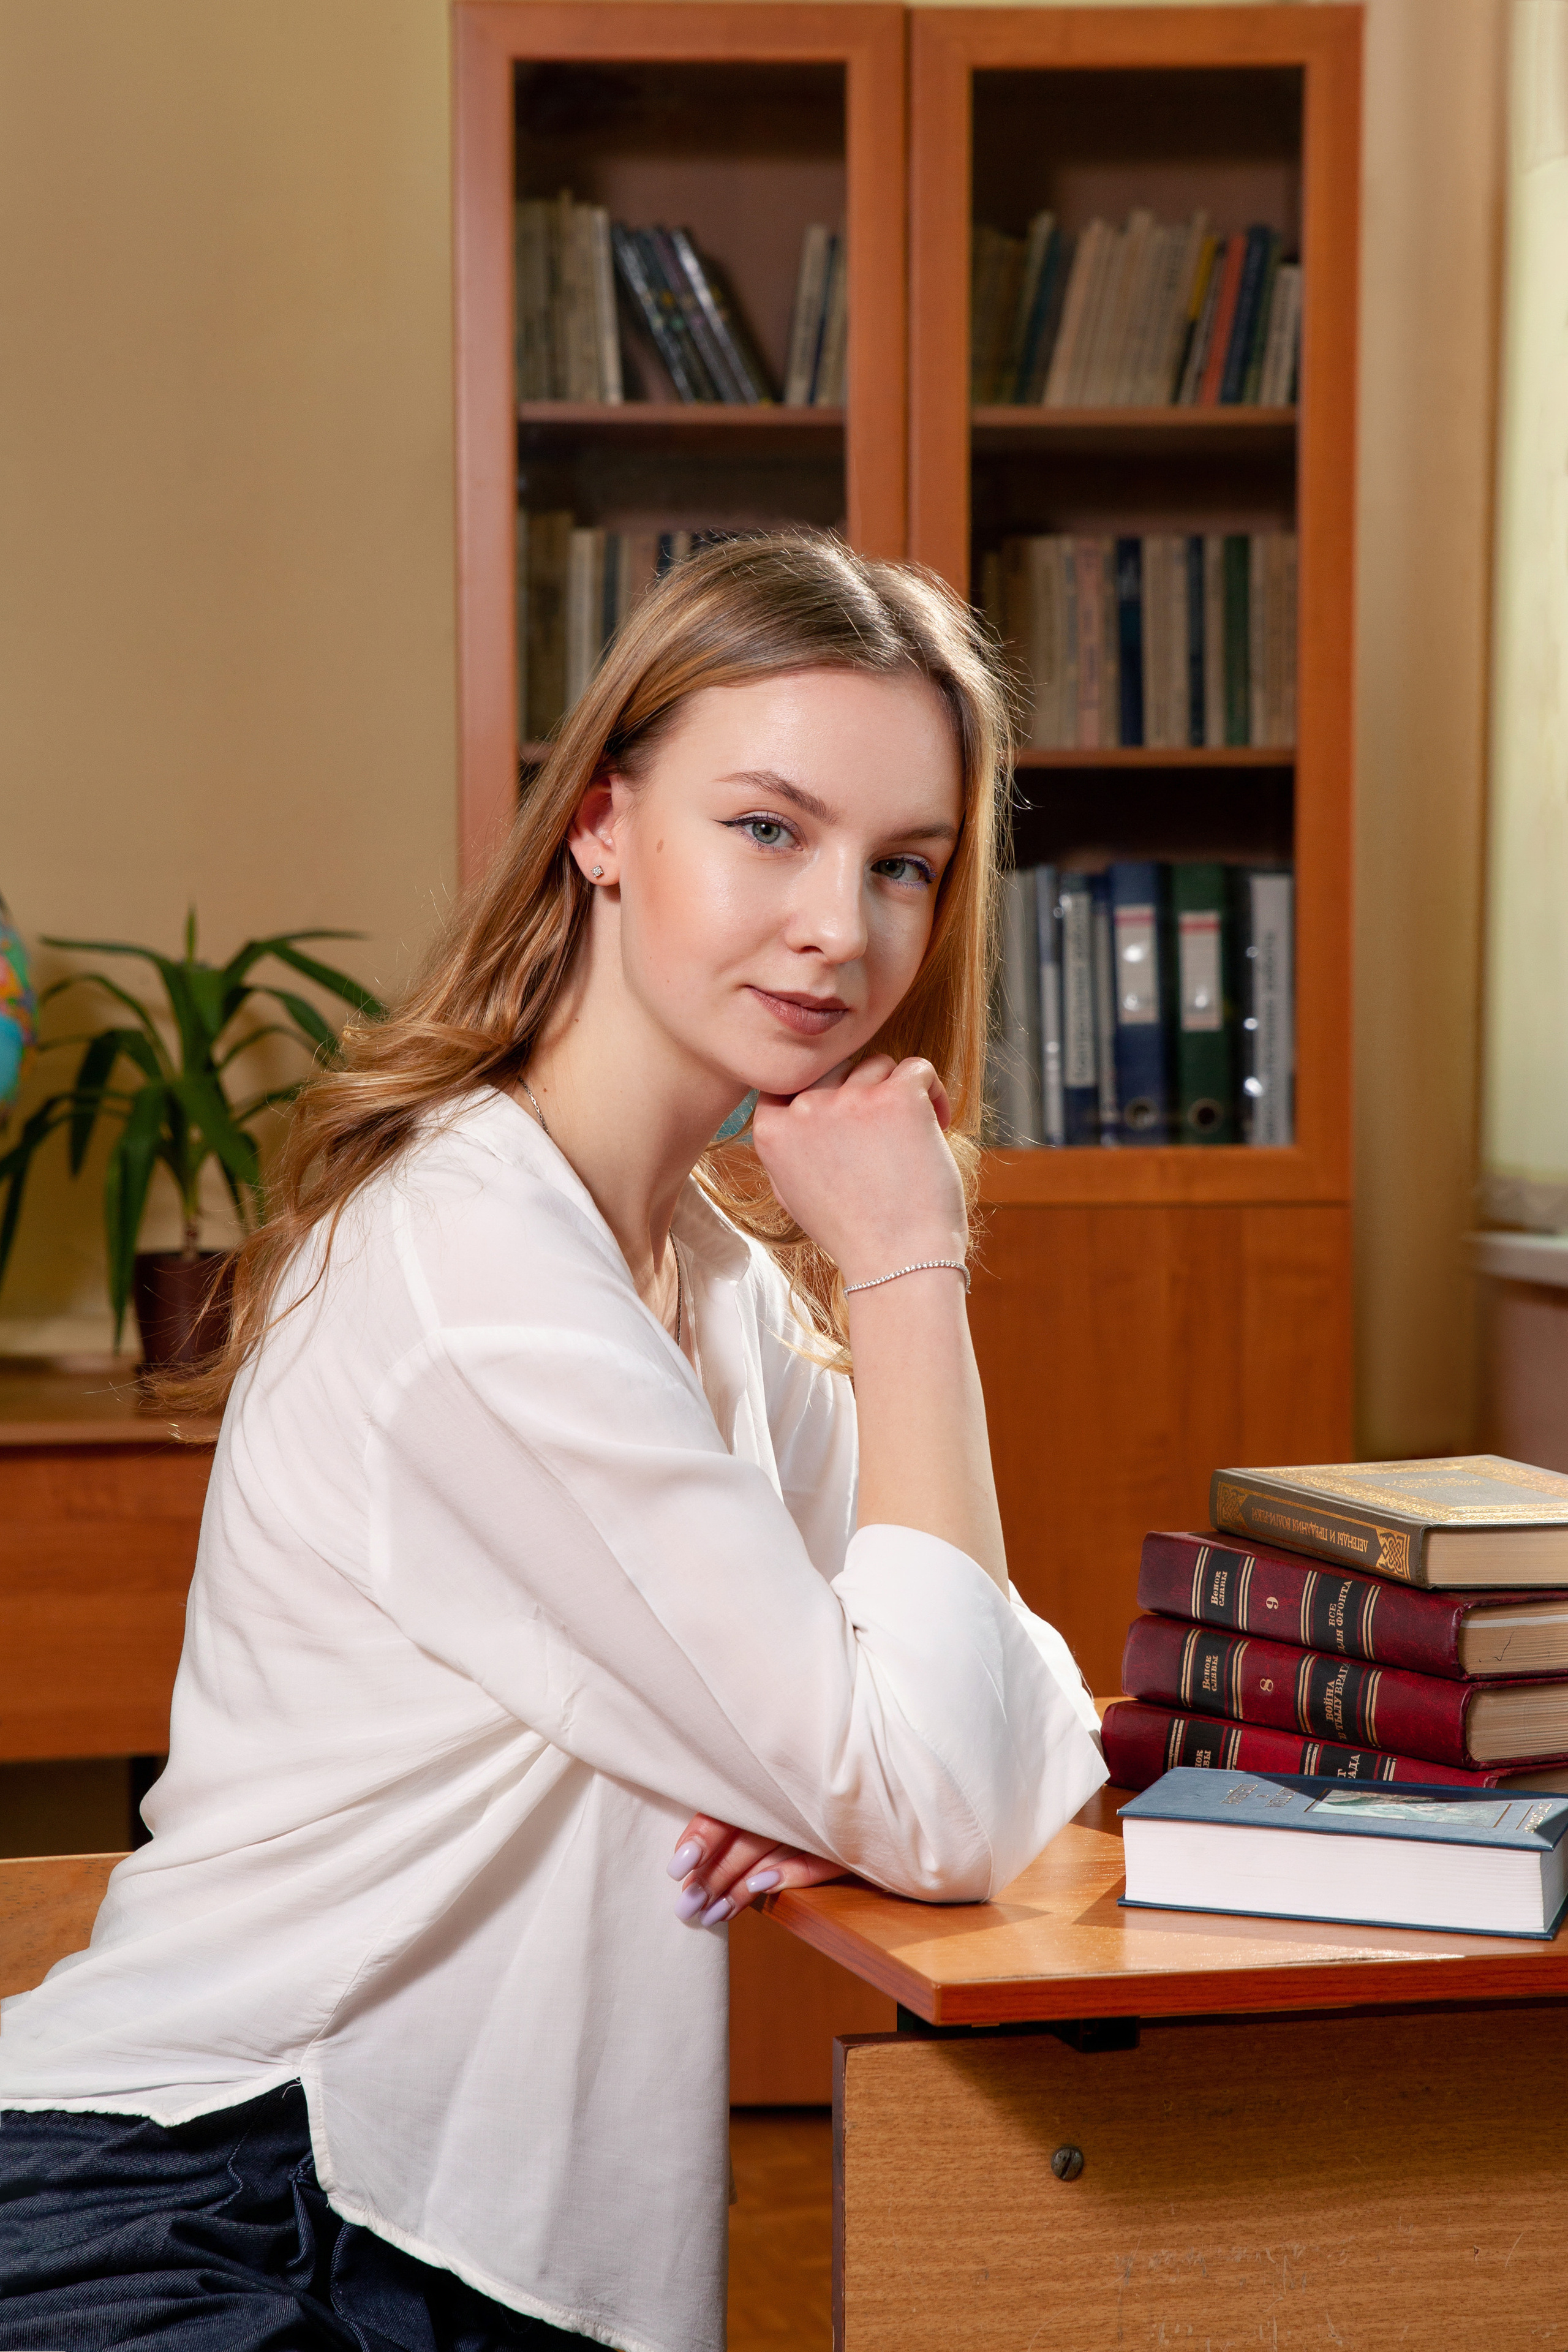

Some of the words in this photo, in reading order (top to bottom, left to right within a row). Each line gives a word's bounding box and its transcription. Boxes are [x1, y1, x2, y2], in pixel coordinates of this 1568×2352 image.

[1292, 1518, 1329, 1542] ПРЕДАНИЯ
[1329, 1529, 1336, 1544] И
[1337, 1531, 1369, 1553] ЛЕГЕНДЫ
[1265, 1596, 1279, 1610] 9
[1336, 1580, 1352, 1627] ФРОНТА
[1336, 1629, 1348, 1654] ДЛЯ
[1259, 1678, 1273, 1692] 8
[1323, 1680, 1335, 1722] ВОЙНА
[1333, 1695, 1344, 1730] ТЫЛУ
